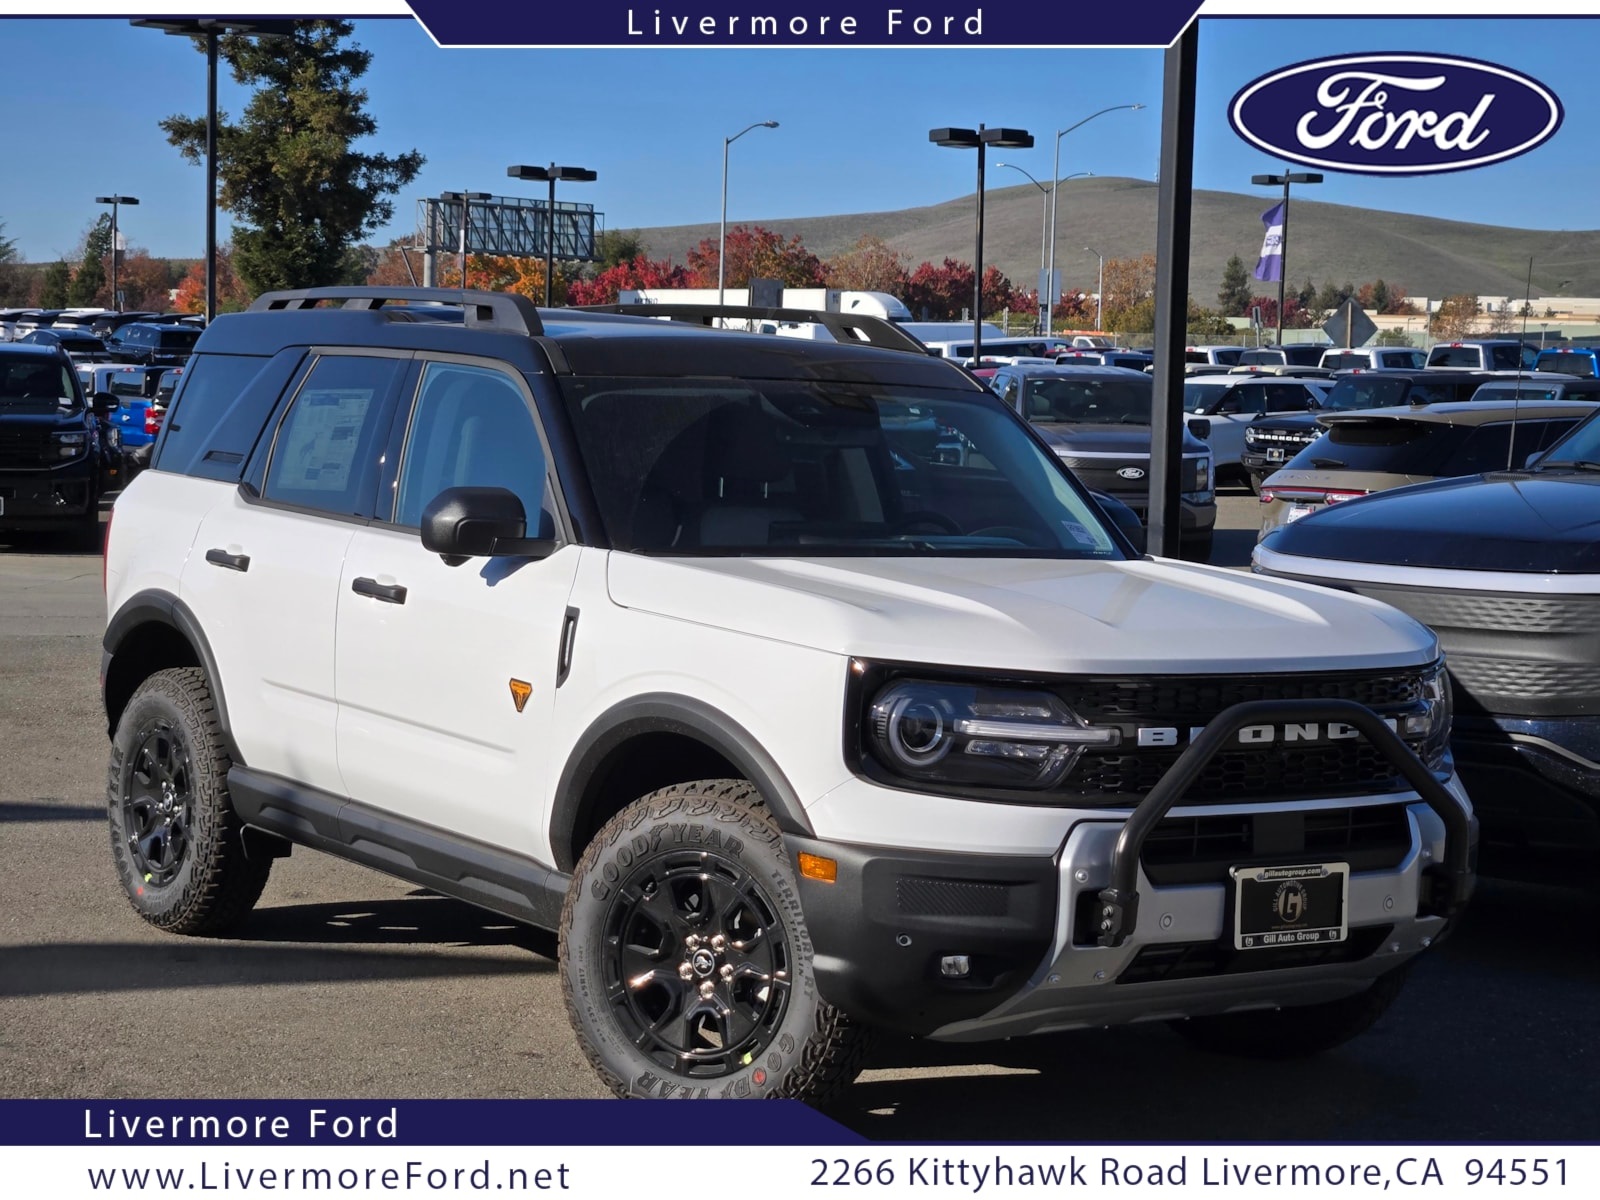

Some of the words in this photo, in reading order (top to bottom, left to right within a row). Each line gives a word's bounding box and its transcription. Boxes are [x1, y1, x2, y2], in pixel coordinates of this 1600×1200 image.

[1138, 718, 1397, 746] BONC
[591, 823, 744, 900] GOODYEAR
[1264, 867, 1321, 879] gillautogroup.com
[1263, 934, 1276, 944] Gill
[1277, 932, 1295, 943] Auto
[1297, 931, 1320, 942] Group
